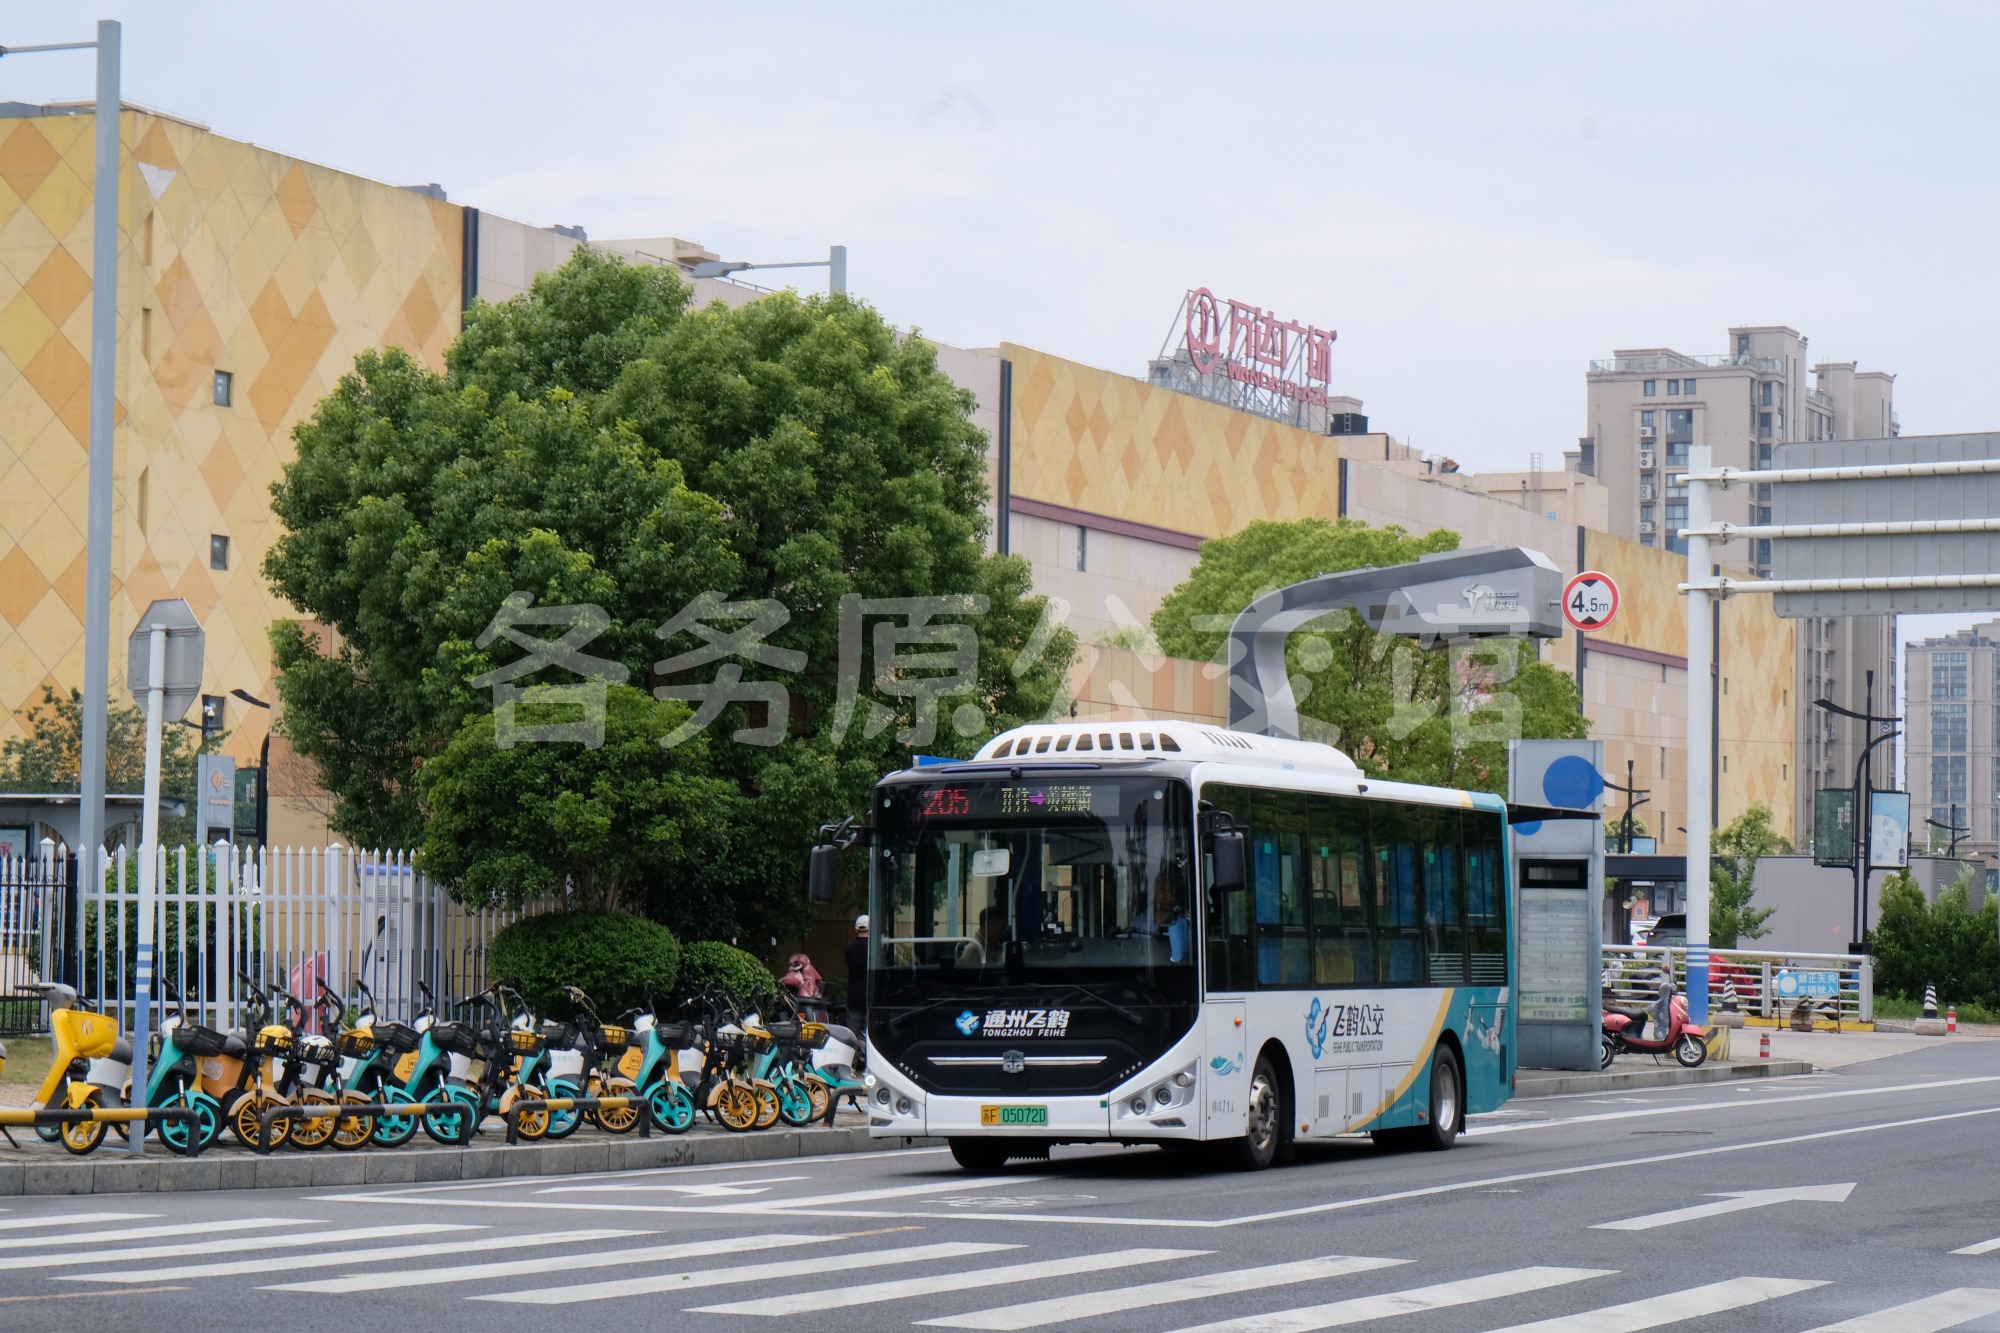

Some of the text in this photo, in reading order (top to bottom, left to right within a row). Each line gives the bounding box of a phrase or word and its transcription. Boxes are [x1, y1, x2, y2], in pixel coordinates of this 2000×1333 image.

[1228, 298, 1337, 385] 万达广场
[1227, 362, 1329, 408] WANDA PLAZA
[1571, 590, 1609, 613] 4.5m
[923, 788, 970, 815] 205
[1798, 973, 1837, 984] 禁止无关
[983, 1009, 1070, 1028] 通州飞鹤
[1332, 1003, 1385, 1037] 飞鹤公交
[982, 1029, 1066, 1037] TONGZHOU FEIHE
